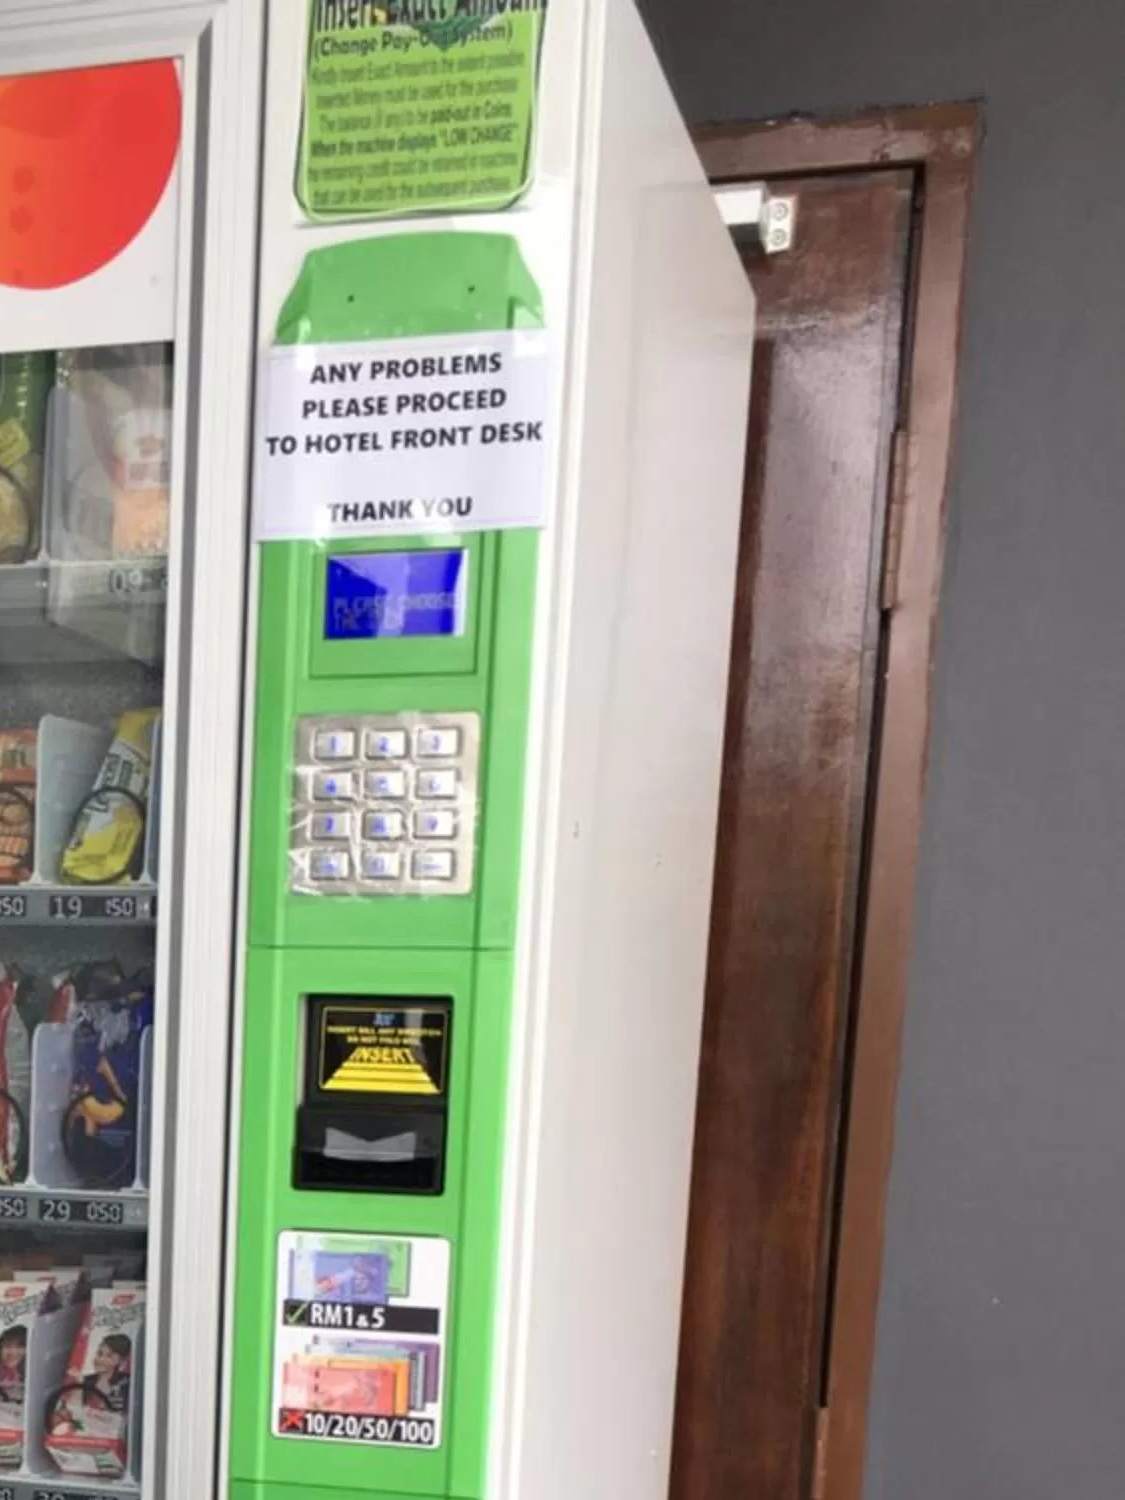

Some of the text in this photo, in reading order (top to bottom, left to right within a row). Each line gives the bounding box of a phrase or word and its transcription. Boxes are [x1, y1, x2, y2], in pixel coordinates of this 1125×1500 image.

[310, 353, 503, 384] ANY PROBLEMS
[302, 388, 507, 420] PLEASE PROCEED
[266, 421, 543, 456] TO HOTEL FRONT DESK
[328, 497, 474, 522] THANK YOU
[54, 896, 83, 918] 19
[349, 1046, 416, 1064] INSERT
[42, 1200, 71, 1222] 29
[305, 1413, 433, 1443] 10/20/50/100
